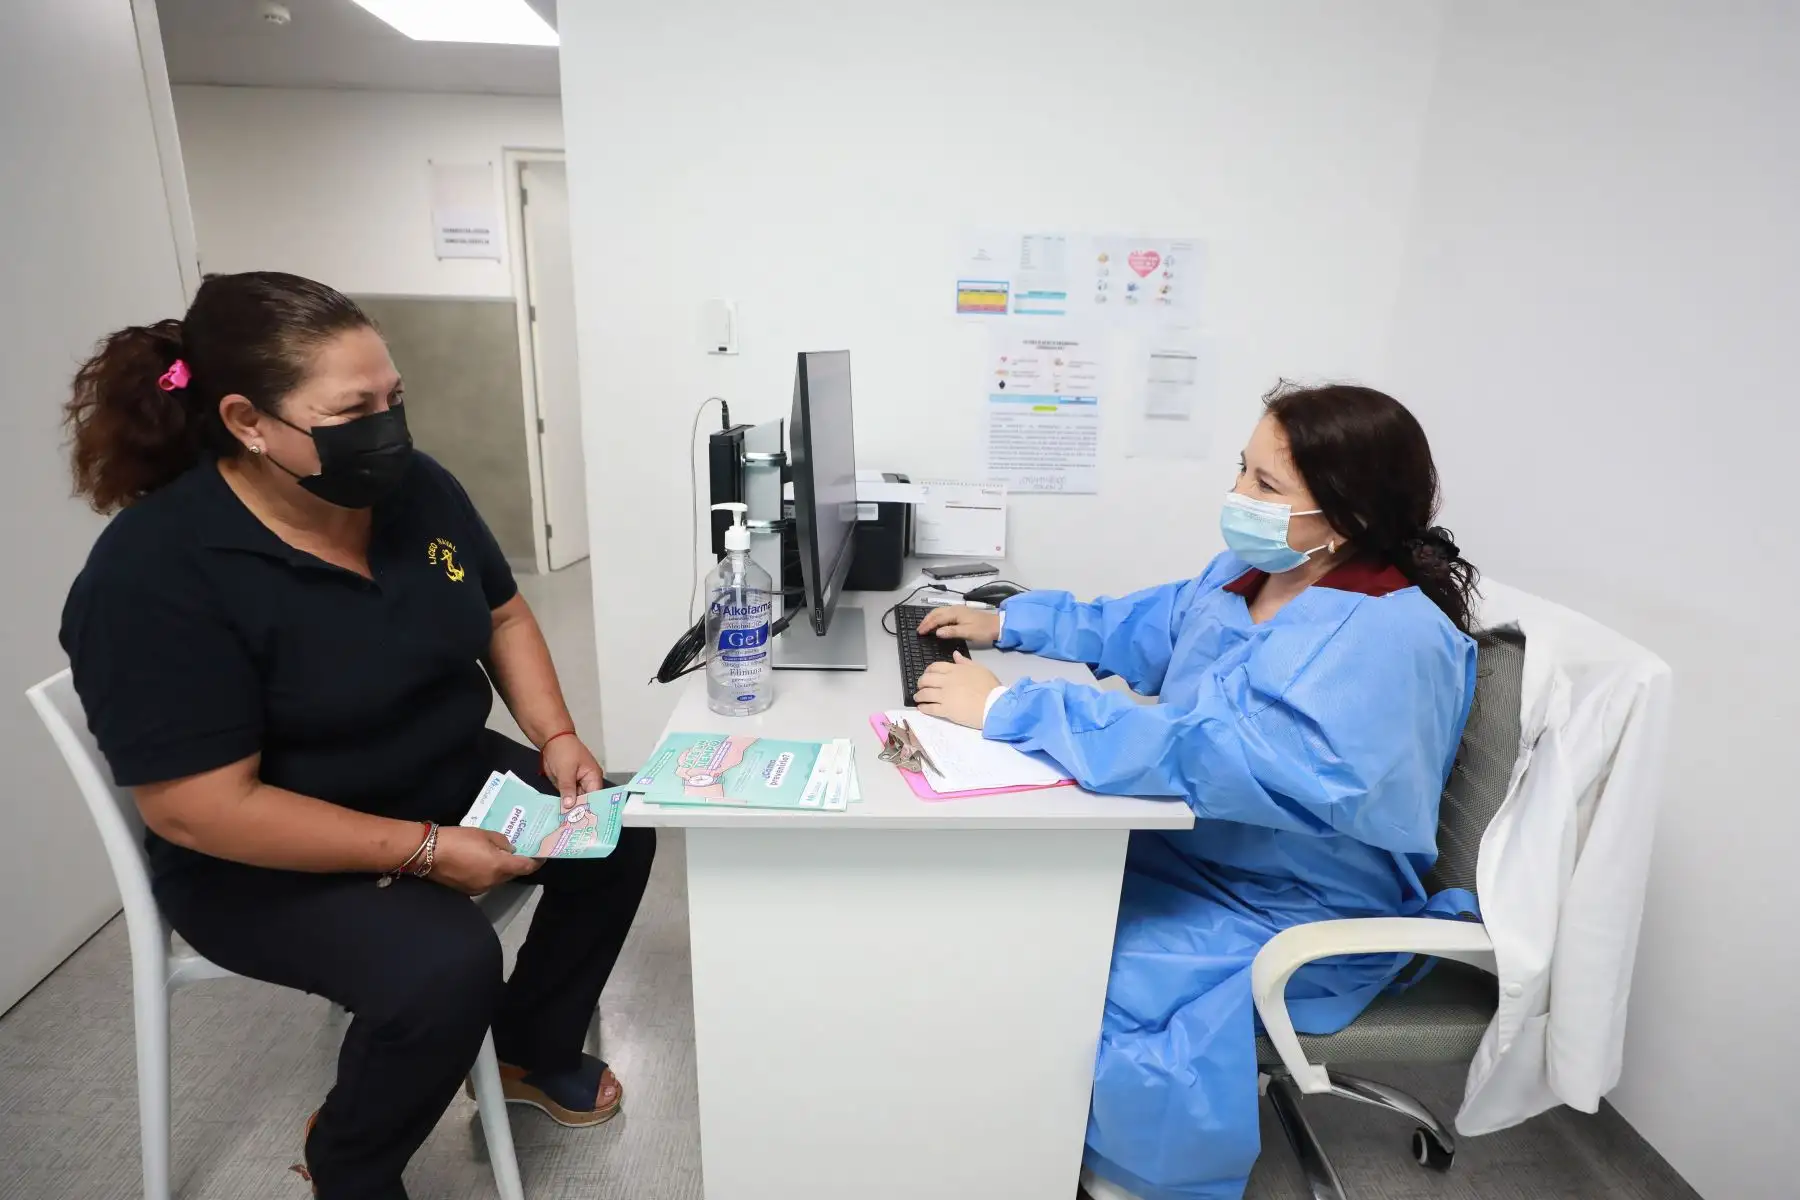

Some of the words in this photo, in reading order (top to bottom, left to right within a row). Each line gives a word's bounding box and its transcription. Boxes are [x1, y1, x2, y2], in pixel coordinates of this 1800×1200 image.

[428, 543, 438, 565] LICEO
[723, 601, 772, 616] Alkofarma
[728, 629, 760, 647] Gel
[770, 754, 790, 786] prevenirlo?
[511, 819, 527, 844] ¿Cómo
